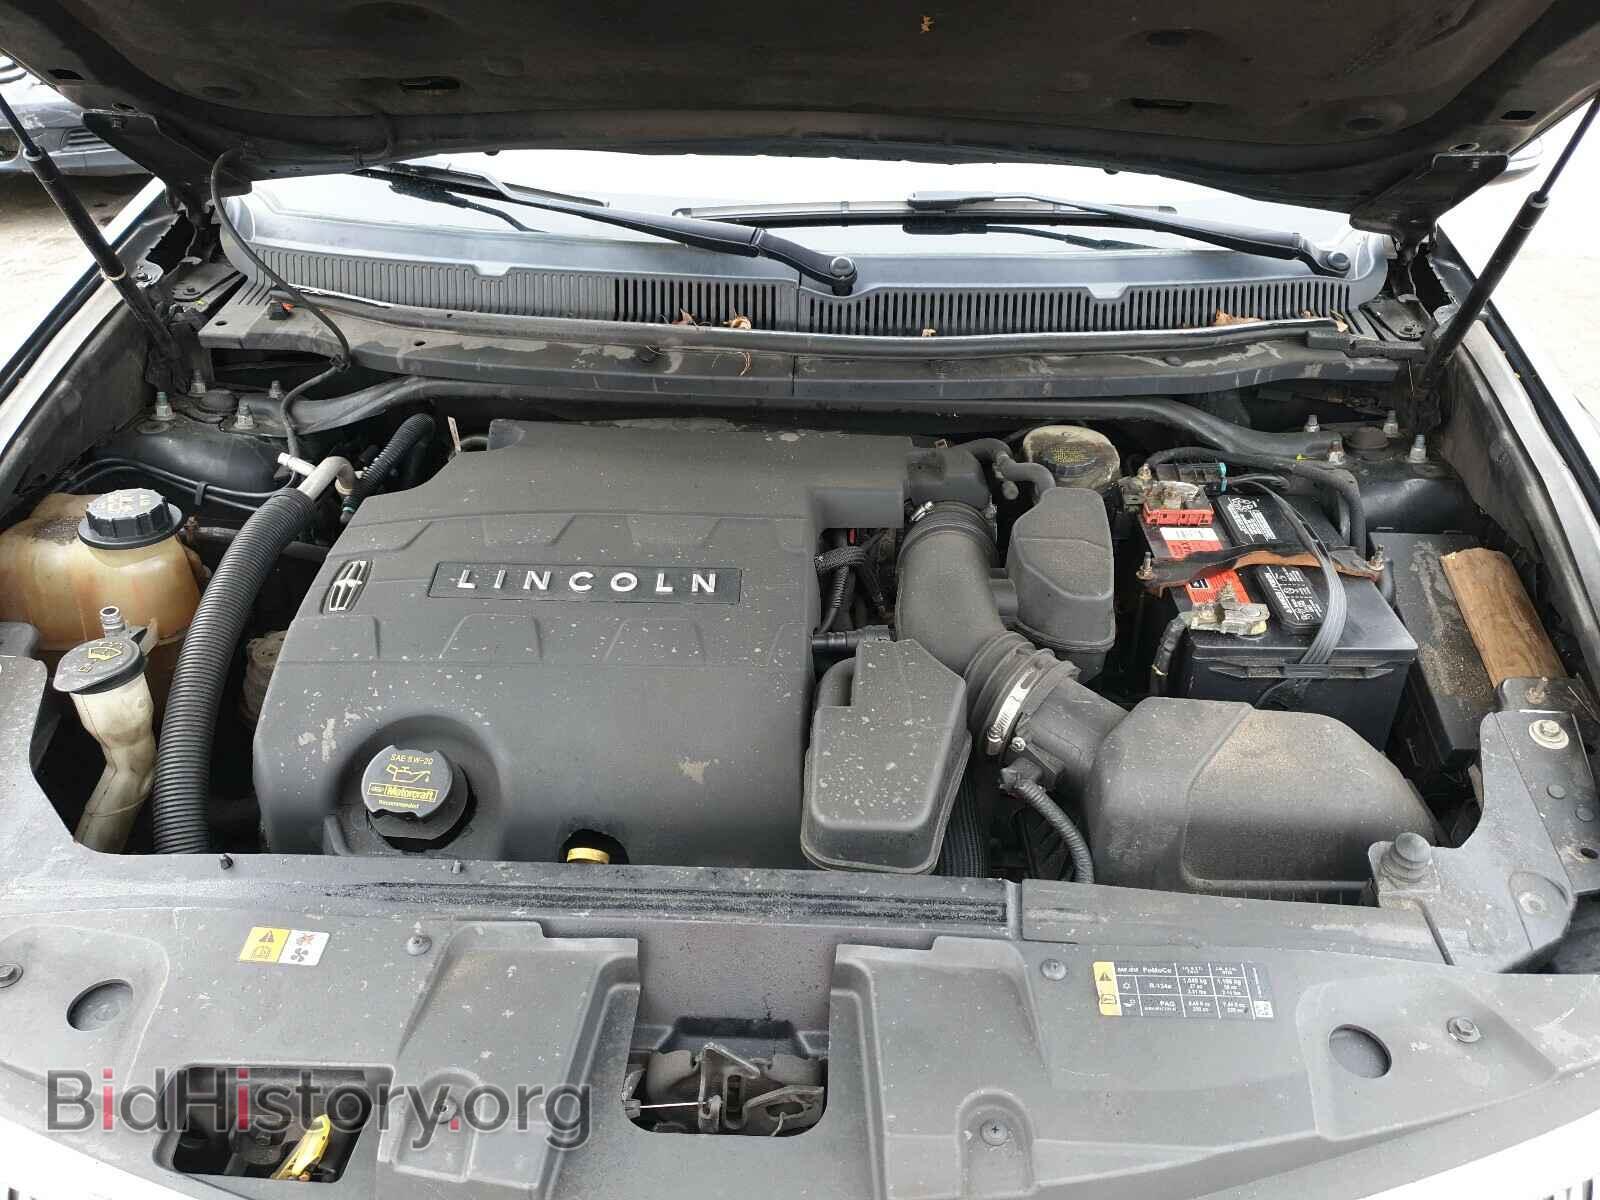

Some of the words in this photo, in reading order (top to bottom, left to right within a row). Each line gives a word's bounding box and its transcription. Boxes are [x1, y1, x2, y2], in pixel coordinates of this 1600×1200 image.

[456, 569, 717, 594] LINCOLN
[390, 753, 406, 763] SAE
[386, 785, 434, 801] Motorcraft
